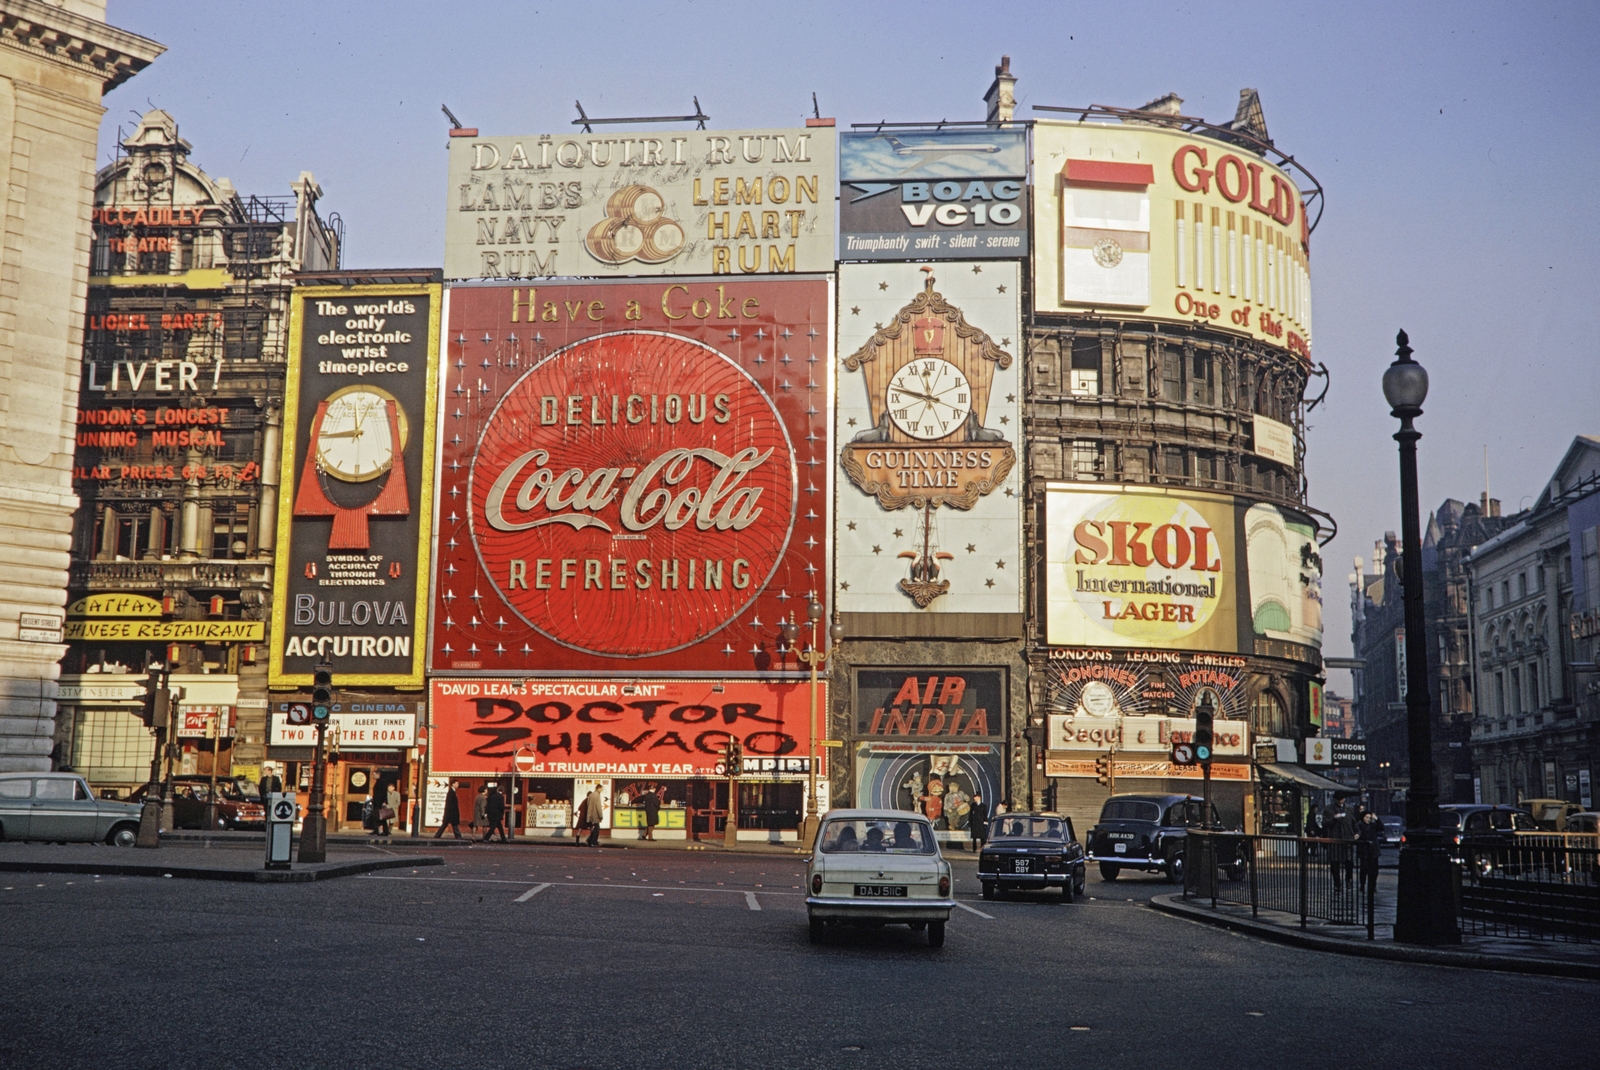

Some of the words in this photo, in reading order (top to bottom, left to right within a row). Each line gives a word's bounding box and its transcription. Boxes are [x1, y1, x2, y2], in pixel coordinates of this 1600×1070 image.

[471, 134, 688, 171] DAÏQUIRI
[706, 133, 811, 164] RUM
[459, 181, 582, 211] LAMB'S
[693, 175, 818, 206] LEMON
[902, 180, 1021, 202] BOAC
[1173, 144, 1295, 227] GOLD
[92, 206, 204, 226] PICCADILLY
[708, 210, 805, 240] HART
[900, 203, 1021, 227] VC10
[476, 215, 566, 245] NAVY
[109, 237, 177, 253] THEATRE
[847, 235, 909, 252] Triumphantly
[915, 234, 940, 249] swift
[949, 233, 978, 248] silent
[987, 235, 1020, 248] serene
[480, 249, 558, 278] RUM
[713, 245, 796, 274] RUM
[316, 301, 348, 316] The
[353, 300, 416, 315] world's
[511, 287, 605, 323] Have
[625, 303, 643, 321] a
[662, 284, 760, 321] Coke
[90, 314, 149, 330] LIONEL
[161, 312, 222, 330] BART'S
[345, 315, 385, 331] only
[1175, 292, 1221, 320] One
[1232, 306, 1251, 328] of
[1260, 311, 1283, 339] the
[318, 330, 411, 345] electronic
[341, 345, 387, 359] wrist
[88, 361, 222, 391] LIVER!
[319, 361, 409, 376] timepiece
[76, 408, 147, 425] ONDON'S
[155, 408, 228, 425] LONGEST
[540, 394, 731, 426] DELICIOUS
[77, 431, 137, 447] UNNING
[152, 430, 226, 447] MUSICAL
[866, 451, 992, 469] GUINNESS
[120, 465, 174, 479] PRICES
[215, 466, 233, 479] TO
[897, 470, 959, 488] TIME
[485, 446, 775, 532] Coca-Cola
[1074, 519, 1221, 572] SKOL
[509, 557, 750, 591] REFRESHING
[1076, 569, 1217, 598] International
[75, 599, 156, 613] CATHAY
[294, 594, 408, 626] BULOVA
[1103, 600, 1196, 622] LAGER
[23, 617, 40, 625] REGENT
[137, 623, 258, 637] RESTAURANT
[285, 636, 410, 657] ACCUTRON
[1126, 651, 1180, 663] LEADING
[1190, 654, 1246, 667] JEWELLERS
[1061, 664, 1138, 688] LONGINES
[1179, 669, 1239, 691] ROTARY
[57, 688, 123, 697] ESTMINSTER
[438, 683, 480, 695] "DAVID
[484, 684, 527, 696] LEAN'S
[531, 684, 617, 696] SPECTACULAR
[621, 685, 665, 696] GANT"
[893, 676, 966, 705] AIR
[351, 704, 406, 712] CINEMA
[465, 697, 785, 725] DOCTOR
[870, 708, 988, 736] INDIA
[1063, 718, 1124, 747] Saqui
[1159, 720, 1240, 747] Lawnce
[281, 730, 304, 740] TWO
[312, 730, 334, 740] FR
[343, 730, 365, 740] THE
[373, 730, 405, 740] ROAD
[465, 727, 798, 758] ZHIVAGO
[1333, 743, 1365, 751] CARTOONS
[1333, 753, 1365, 761] COMEDIES
[548, 762, 648, 773] TRIUMPHANT
[652, 763, 693, 774] YEAR
[743, 759, 809, 771] MPIR
[860, 887, 880, 896] DAJ
